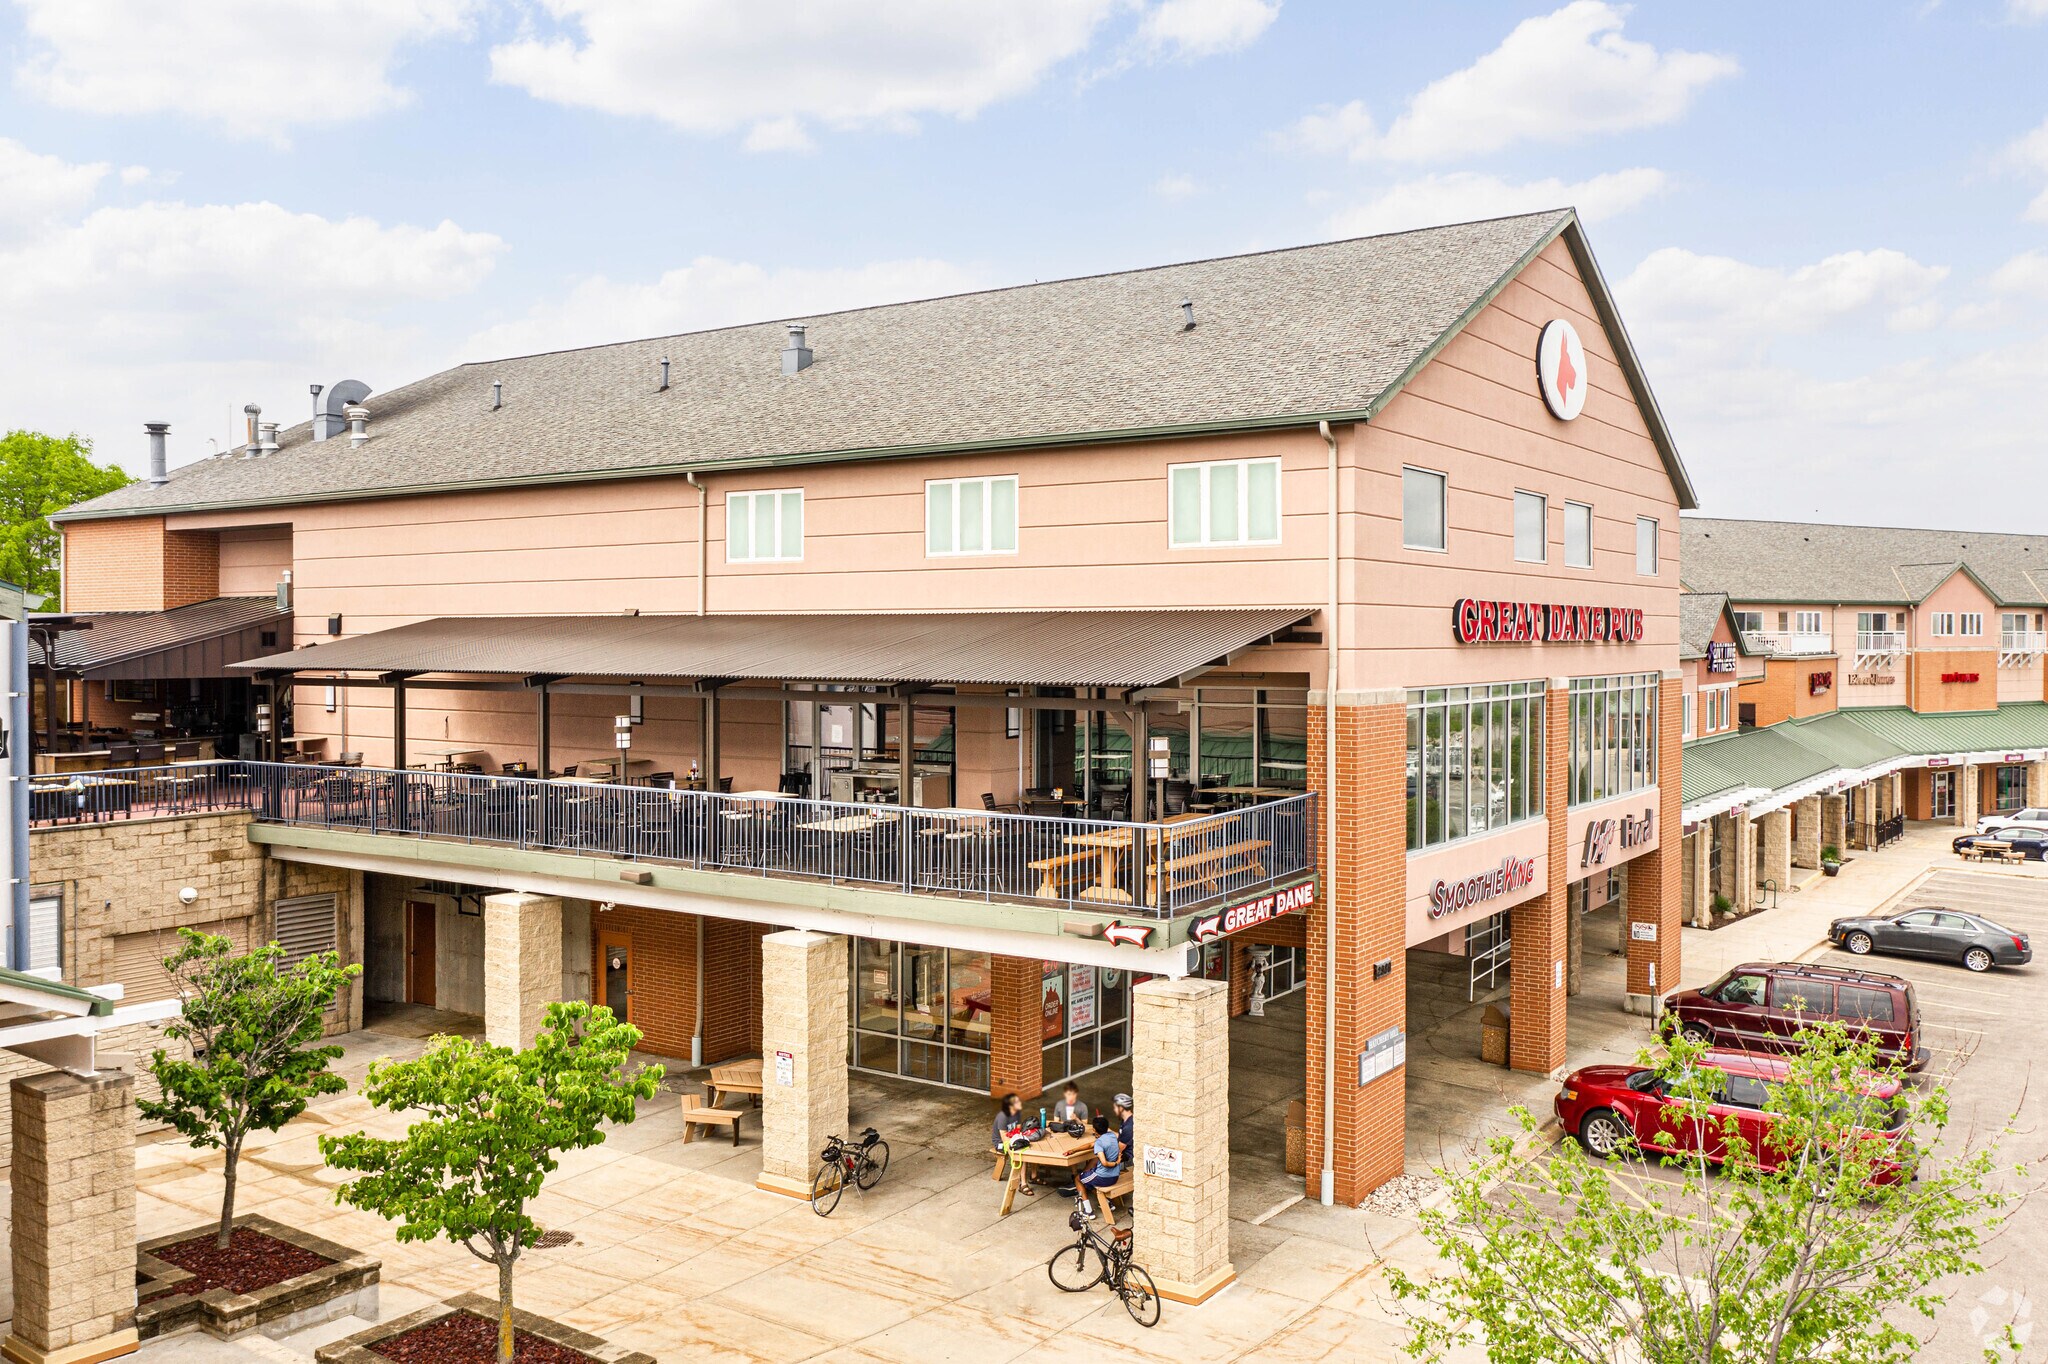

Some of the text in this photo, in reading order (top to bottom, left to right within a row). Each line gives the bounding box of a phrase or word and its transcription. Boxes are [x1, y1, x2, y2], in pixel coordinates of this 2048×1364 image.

[1457, 598, 1644, 643] GREAT DANE PUB
[1622, 808, 1654, 849] Floral
[1223, 882, 1314, 933] GREAT DANE
[1430, 856, 1534, 919] SMOOTHIE KING
[1044, 999, 1059, 1011] ORDER
[1044, 1007, 1059, 1018] ONLINE
[1145, 1160, 1156, 1175] NO
